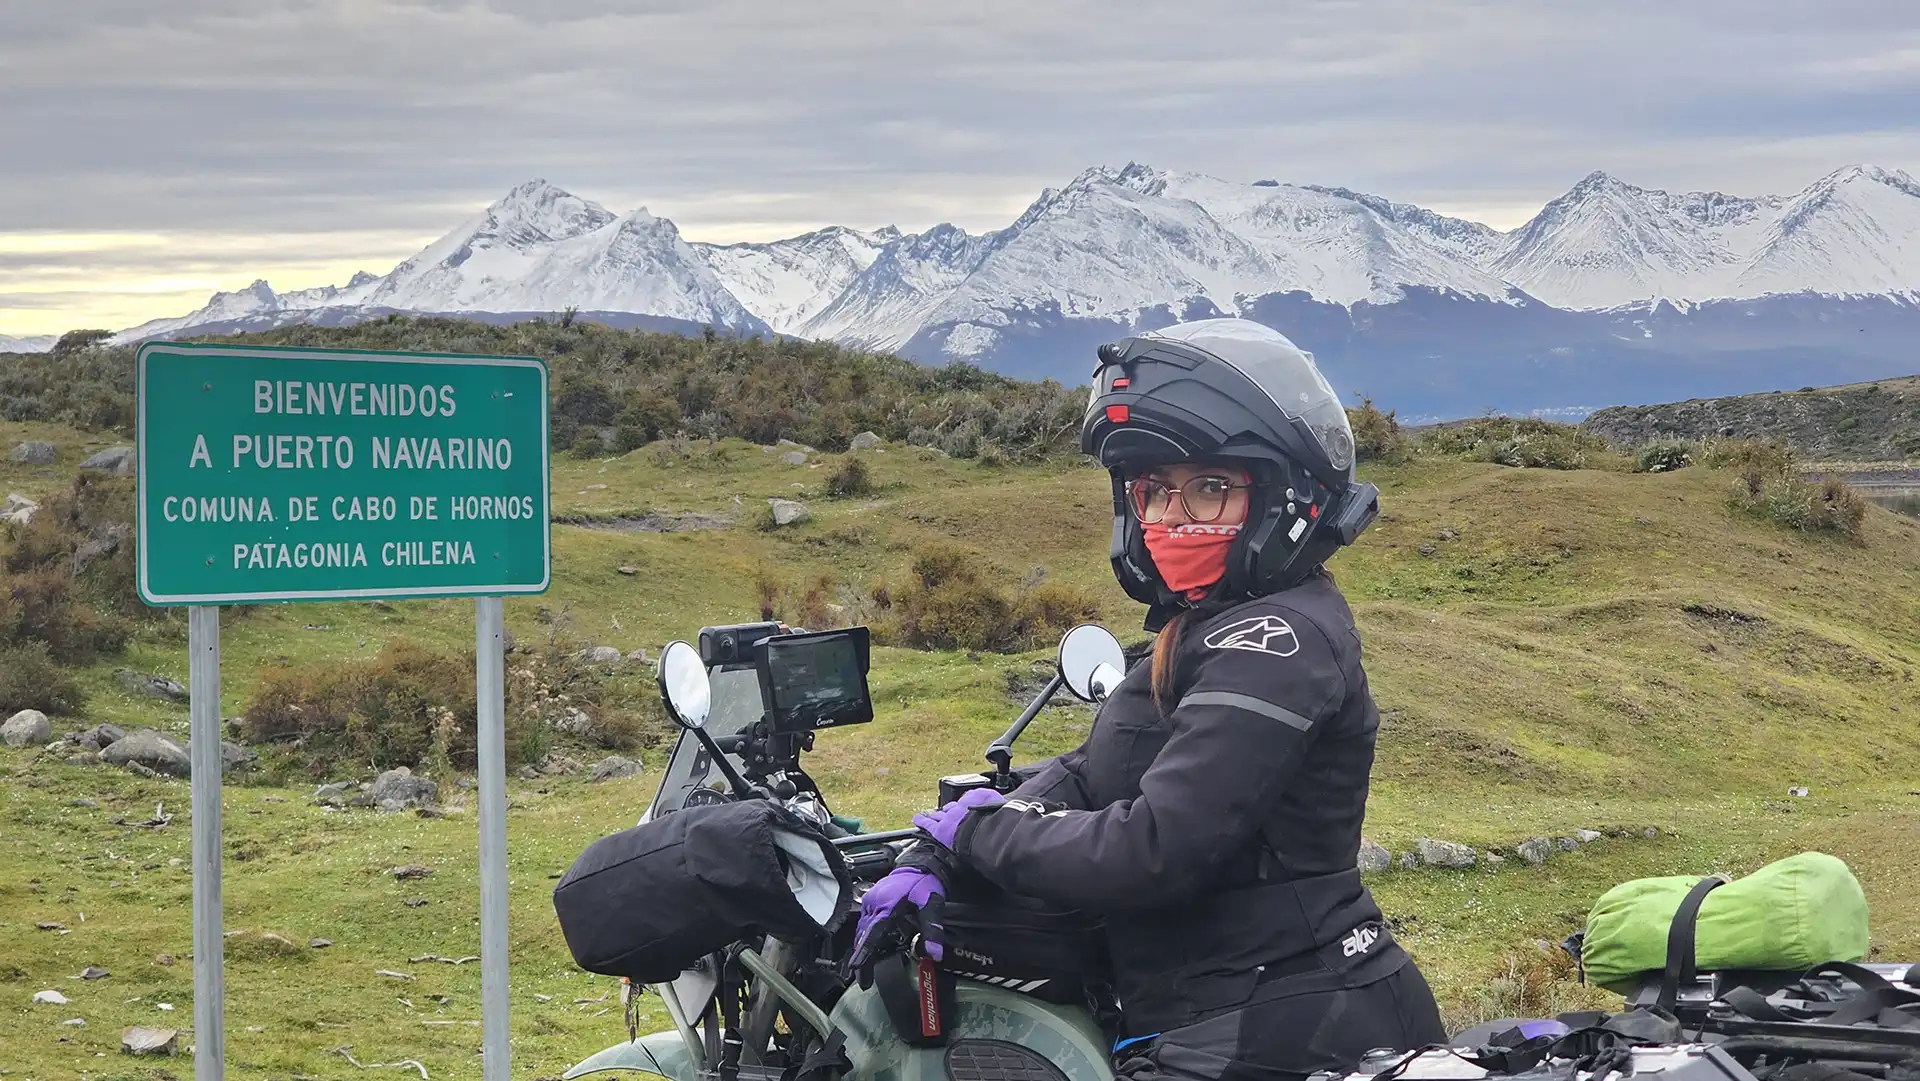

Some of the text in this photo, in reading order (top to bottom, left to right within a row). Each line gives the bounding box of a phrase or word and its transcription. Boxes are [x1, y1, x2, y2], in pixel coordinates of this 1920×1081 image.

[254, 379, 457, 417] BIENVENIDOS
[189, 433, 513, 470] A PUERTO NAVARINO
[163, 494, 535, 523] COMUNA DE CABO DE HORNOS
[233, 541, 477, 570] PATAGONIA CHILENA
